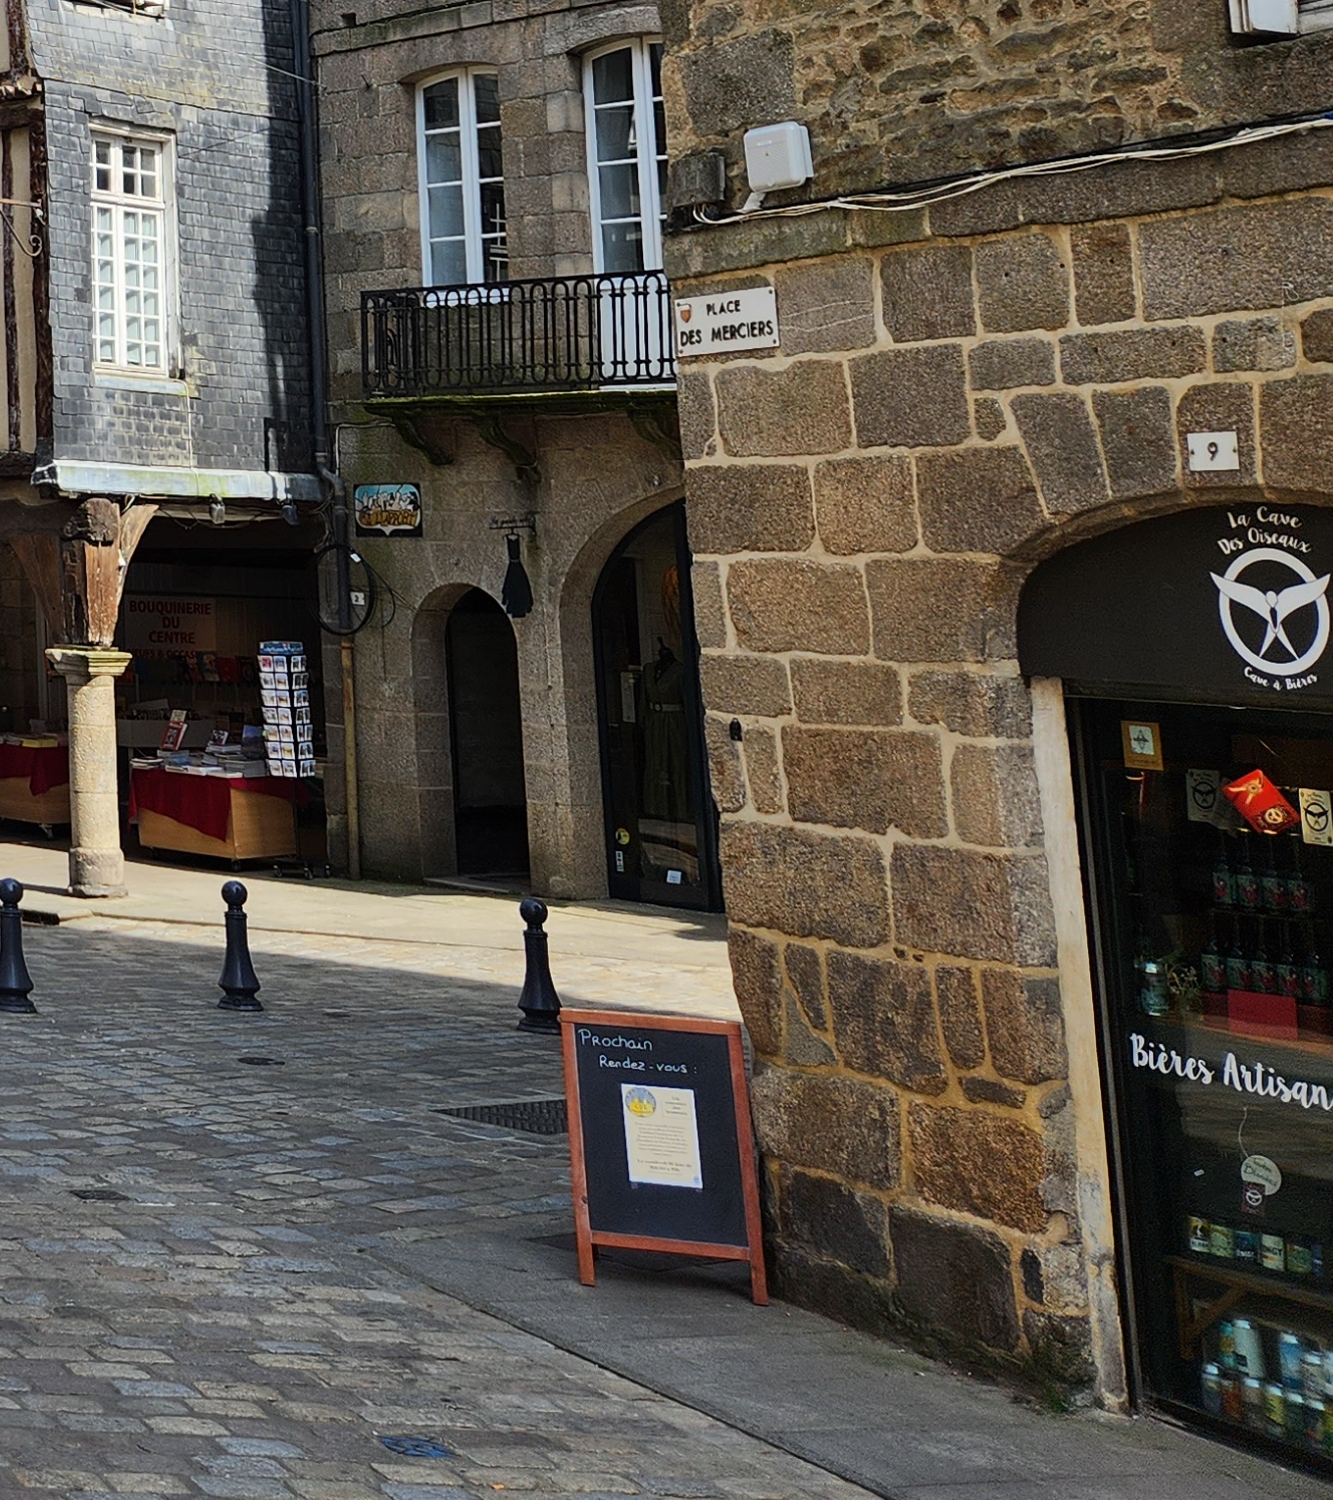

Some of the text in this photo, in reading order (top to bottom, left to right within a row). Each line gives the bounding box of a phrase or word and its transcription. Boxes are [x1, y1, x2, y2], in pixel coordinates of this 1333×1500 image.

[706, 300, 741, 316] PLACE
[680, 320, 774, 347] DES MERCIERS
[1206, 441, 1219, 461] 9
[1227, 506, 1302, 529] La Cave
[1217, 527, 1312, 555] Des Oiseaux
[129, 600, 211, 615] BOUQUINERIE
[162, 616, 180, 629] DU
[149, 631, 195, 644] CENTRE
[1244, 666, 1269, 687] Cave
[578, 1028, 653, 1051] Prochain
[1129, 1032, 1216, 1085] Bières
